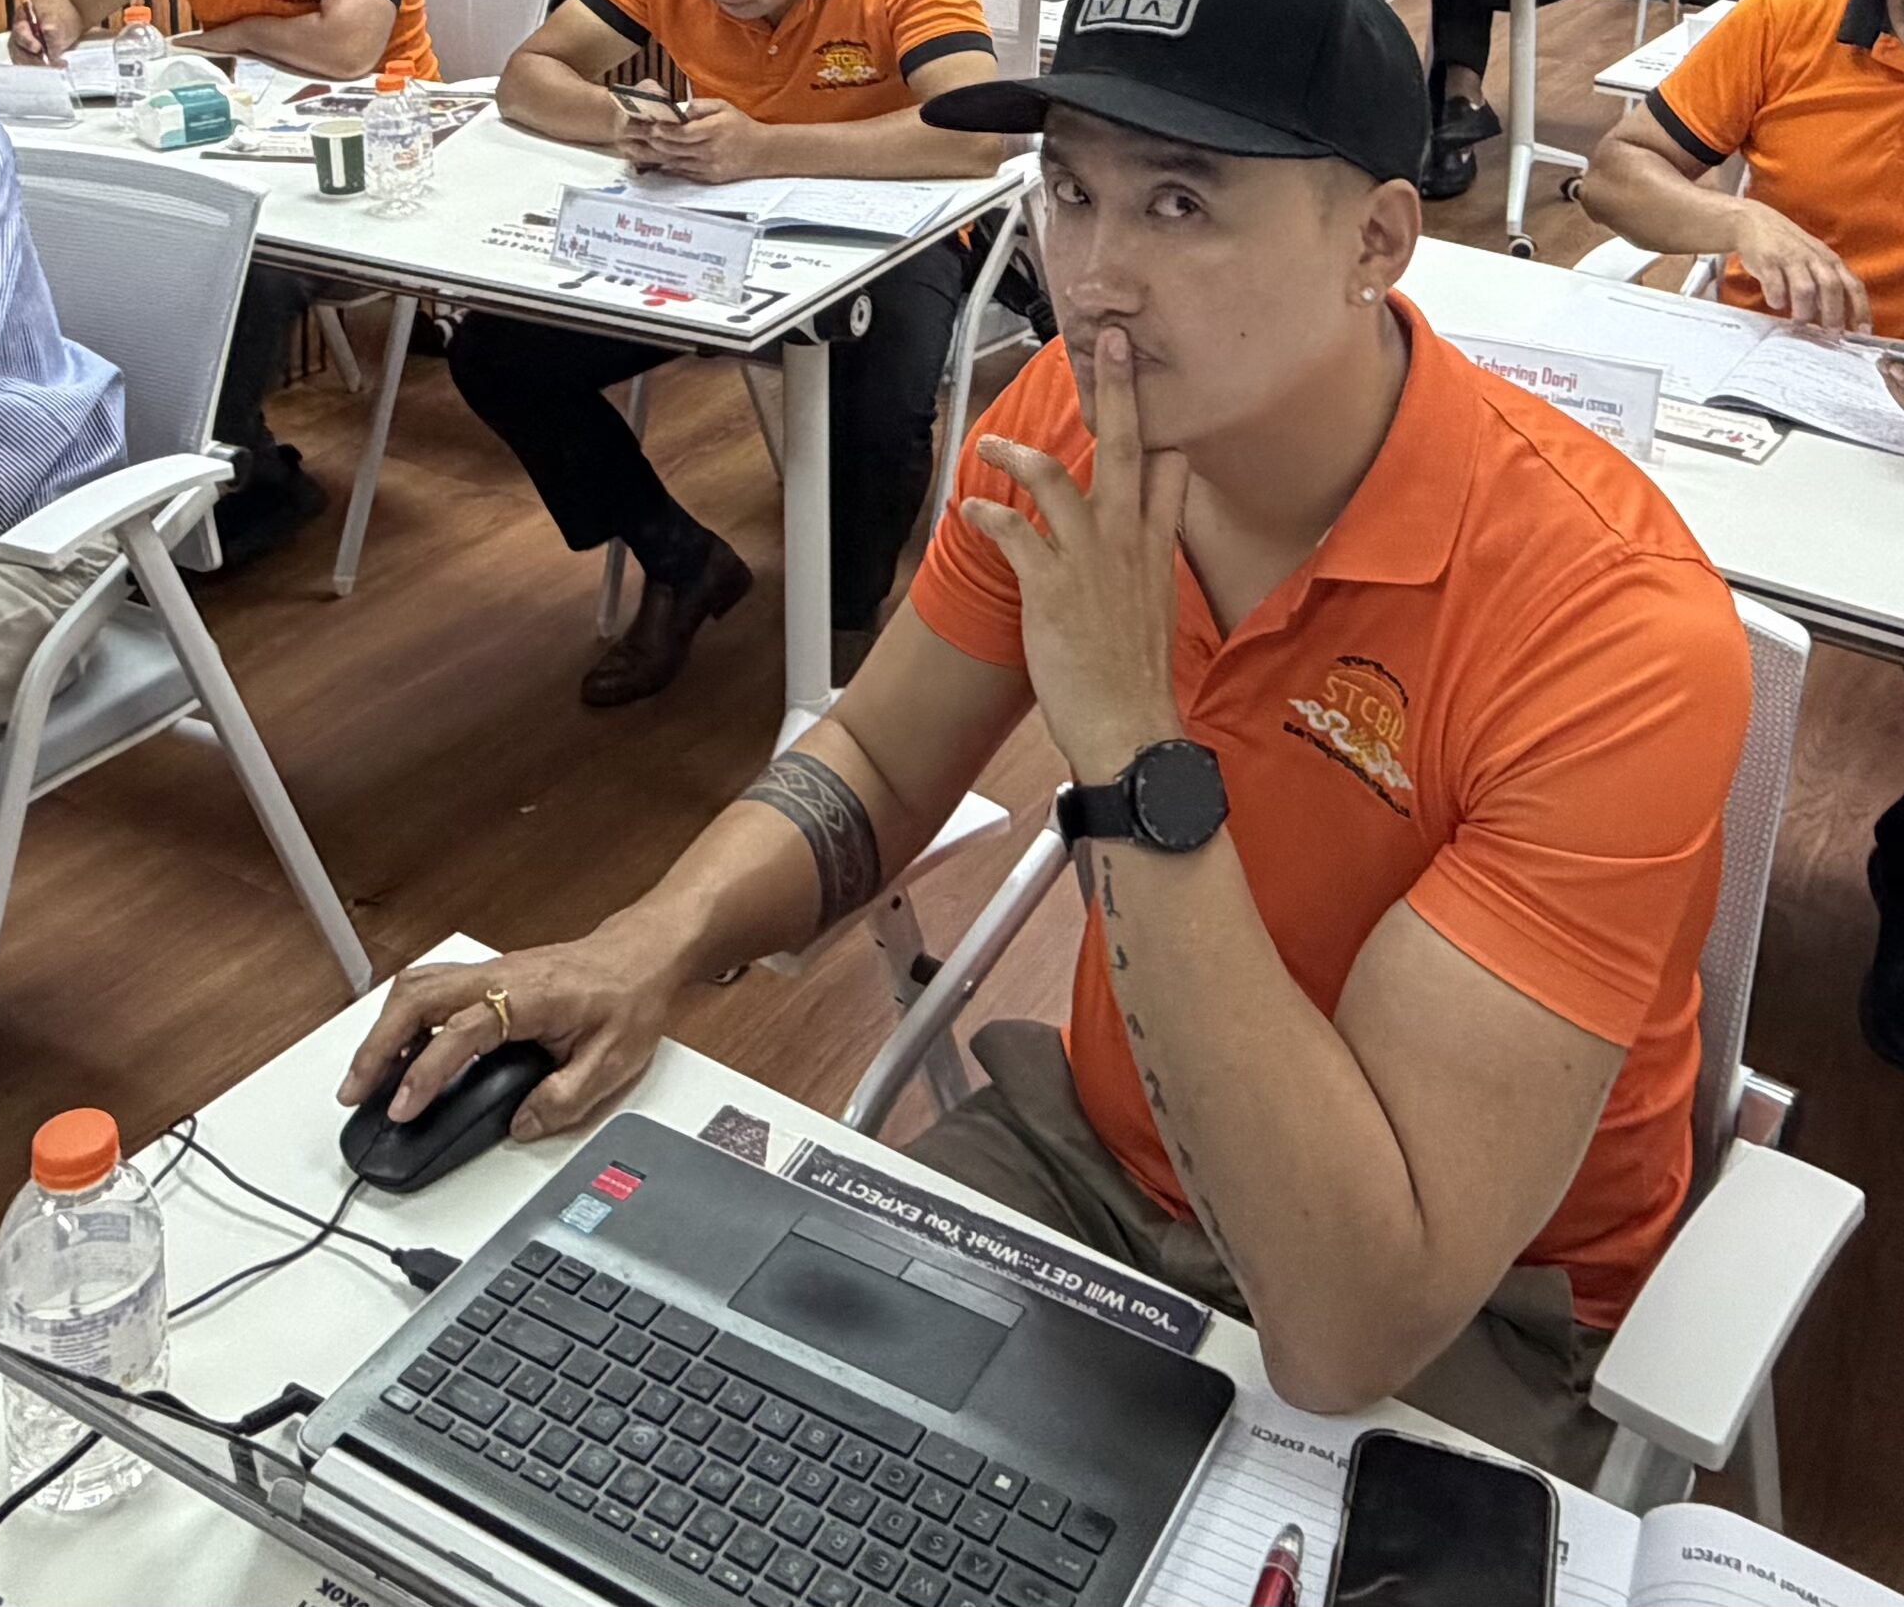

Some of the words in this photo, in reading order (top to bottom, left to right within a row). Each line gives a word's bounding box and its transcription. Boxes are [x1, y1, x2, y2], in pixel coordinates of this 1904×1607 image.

[1541, 367, 1578, 391] Dorji
[834, 1175, 923, 1222] EXPECT
[923, 1211, 963, 1244] You
[1085, 1279, 1126, 1312] Will
[1746, 1562, 1778, 1589] you
